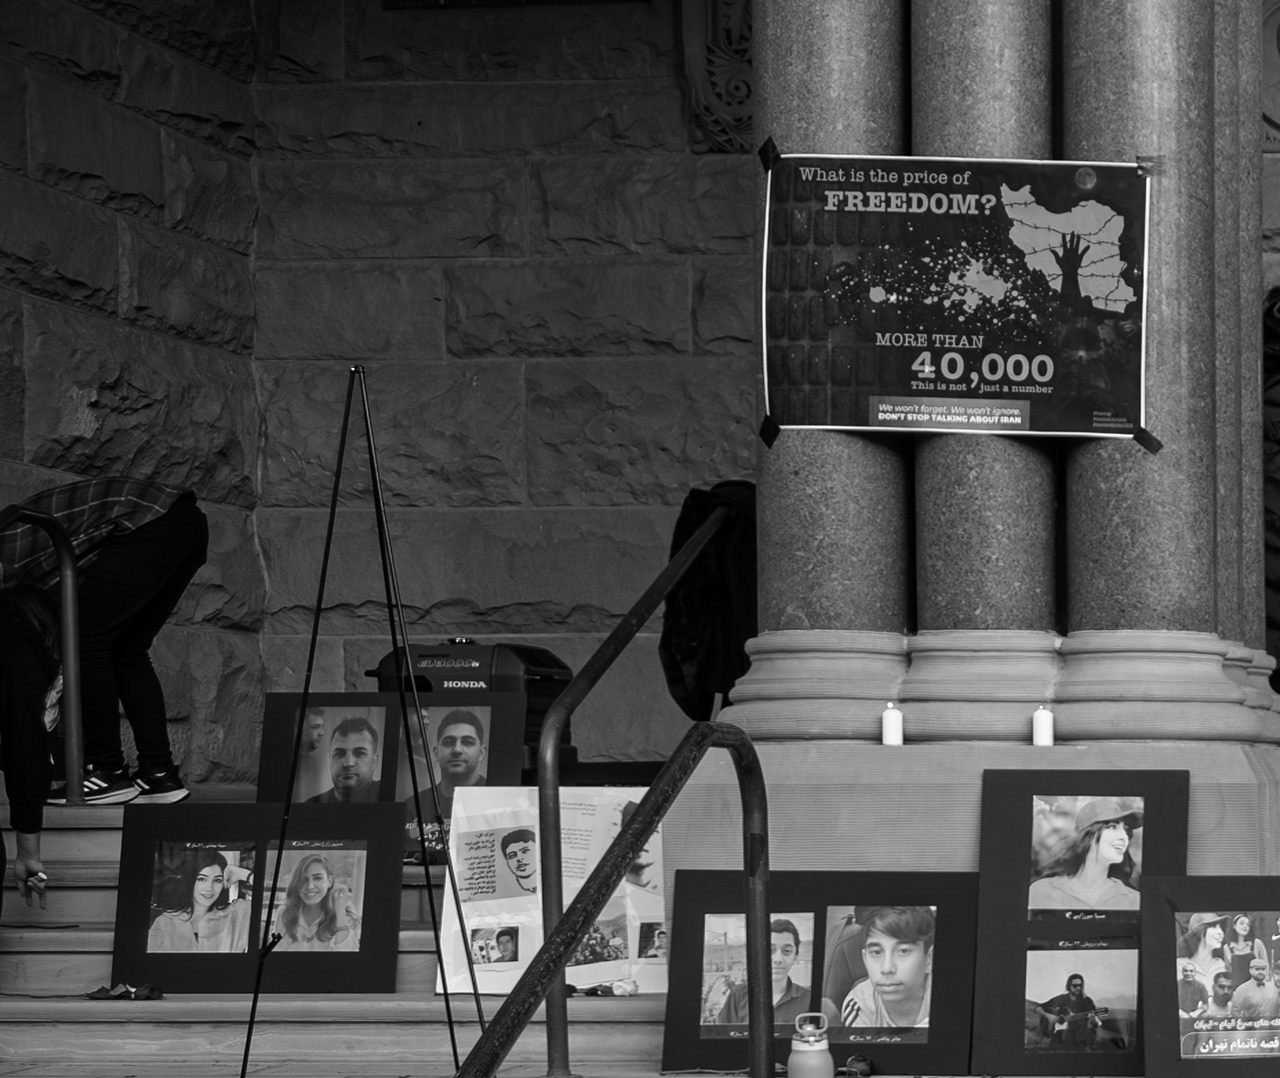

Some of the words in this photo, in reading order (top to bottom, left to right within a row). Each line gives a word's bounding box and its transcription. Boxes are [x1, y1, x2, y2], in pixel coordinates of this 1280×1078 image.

[799, 166, 846, 184] What
[849, 167, 865, 184] is
[869, 167, 897, 184] the
[901, 170, 948, 189] price
[951, 170, 971, 187] of
[823, 190, 997, 216] FREEDOM?
[875, 332, 928, 348] MORE
[931, 334, 985, 350] THAN
[910, 350, 1056, 389] 40,000
[910, 380, 934, 392] This
[936, 381, 947, 392] is
[948, 382, 968, 393] not
[979, 382, 1000, 395] just
[1002, 386, 1009, 394] a
[1010, 382, 1055, 395] number
[878, 402, 895, 415] We
[896, 403, 920, 415] won't
[921, 404, 949, 418] forget.
[951, 404, 966, 417] We
[967, 405, 992, 417] won't
[992, 406, 1023, 418] ignore.
[878, 412, 906, 422] DON'T
[907, 412, 931, 422] STOP
[931, 413, 968, 424] TALKING
[969, 414, 999, 424] ABOUT
[1000, 415, 1023, 425] IRAN
[443, 680, 488, 689] HONDA
[1199, 1038, 1229, 1054] تهران
